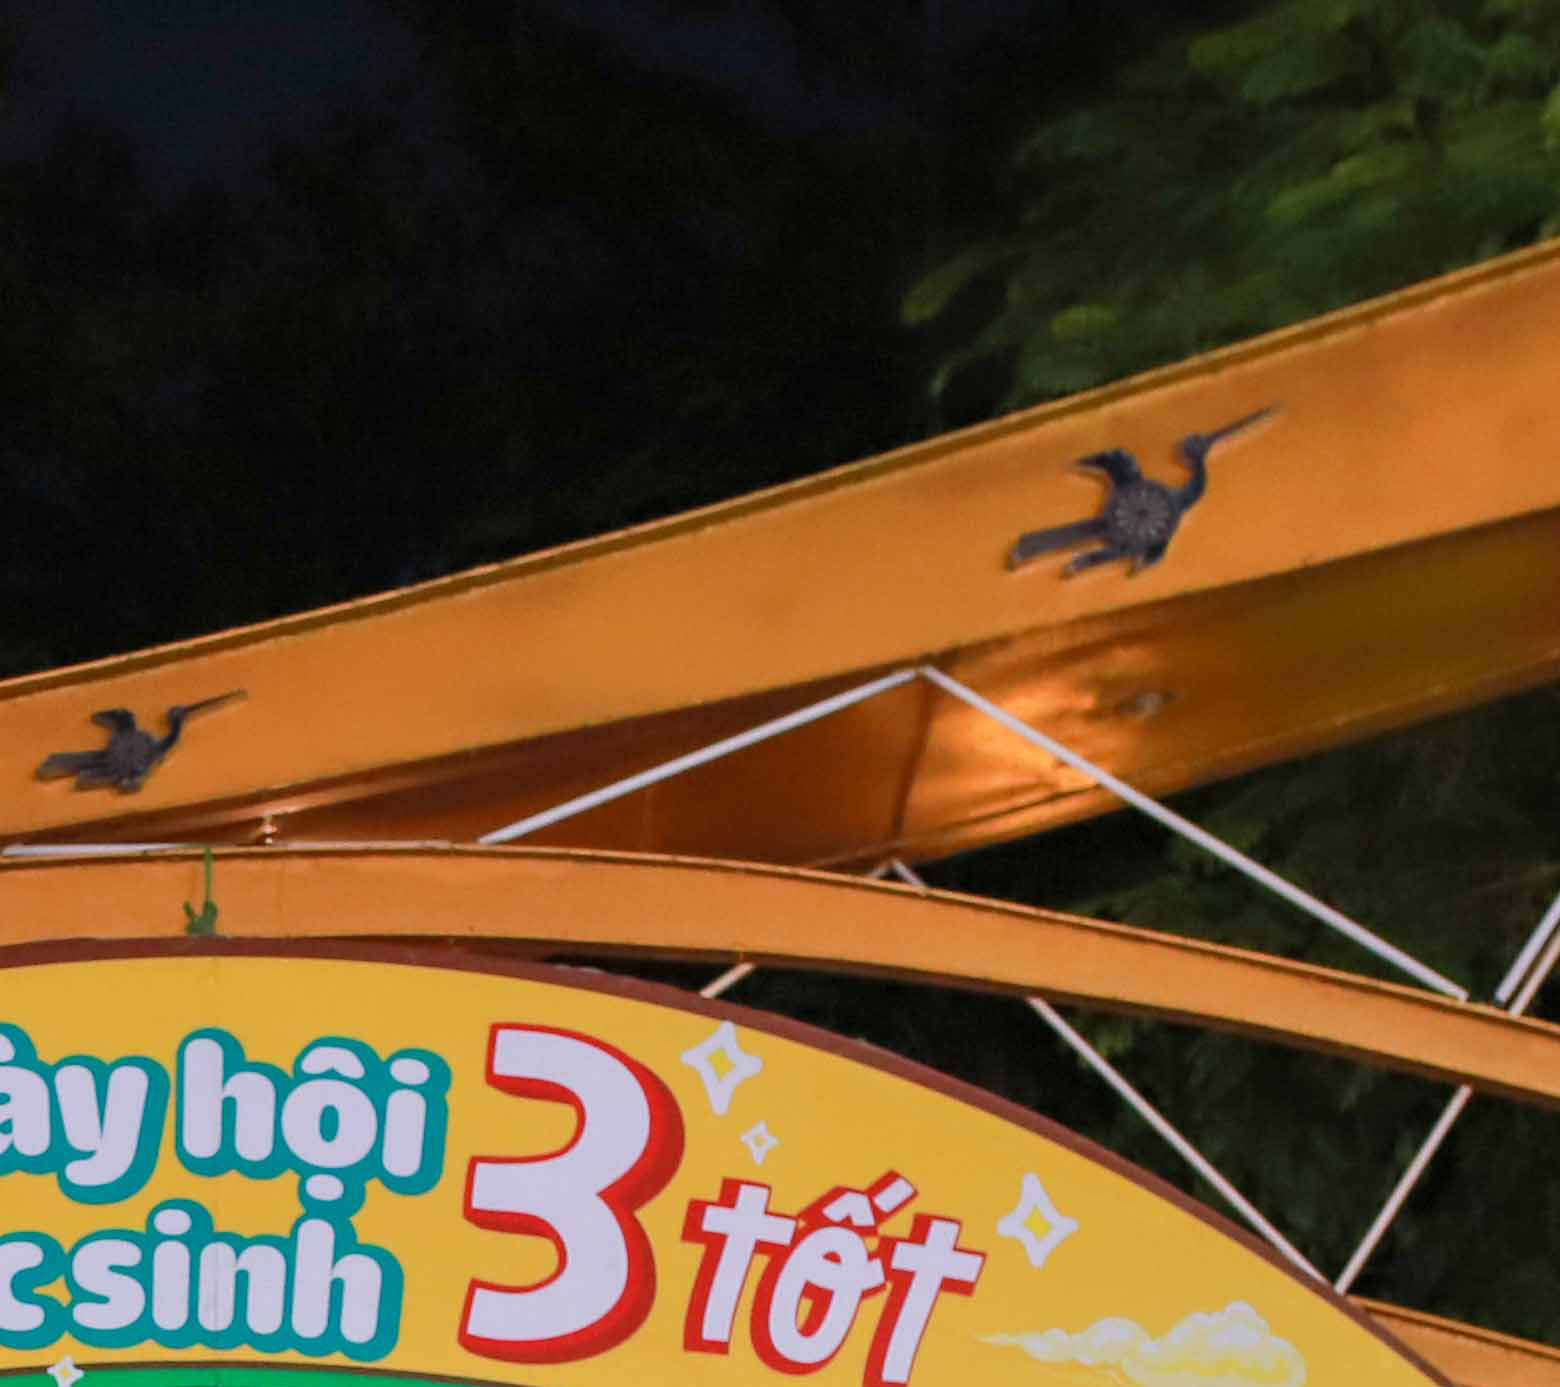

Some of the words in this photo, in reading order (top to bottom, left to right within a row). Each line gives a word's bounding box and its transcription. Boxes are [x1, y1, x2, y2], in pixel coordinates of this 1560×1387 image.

[183, 1035, 442, 1206] hội
[460, 1023, 675, 1355] 3
[68, 1207, 387, 1350] sinh
